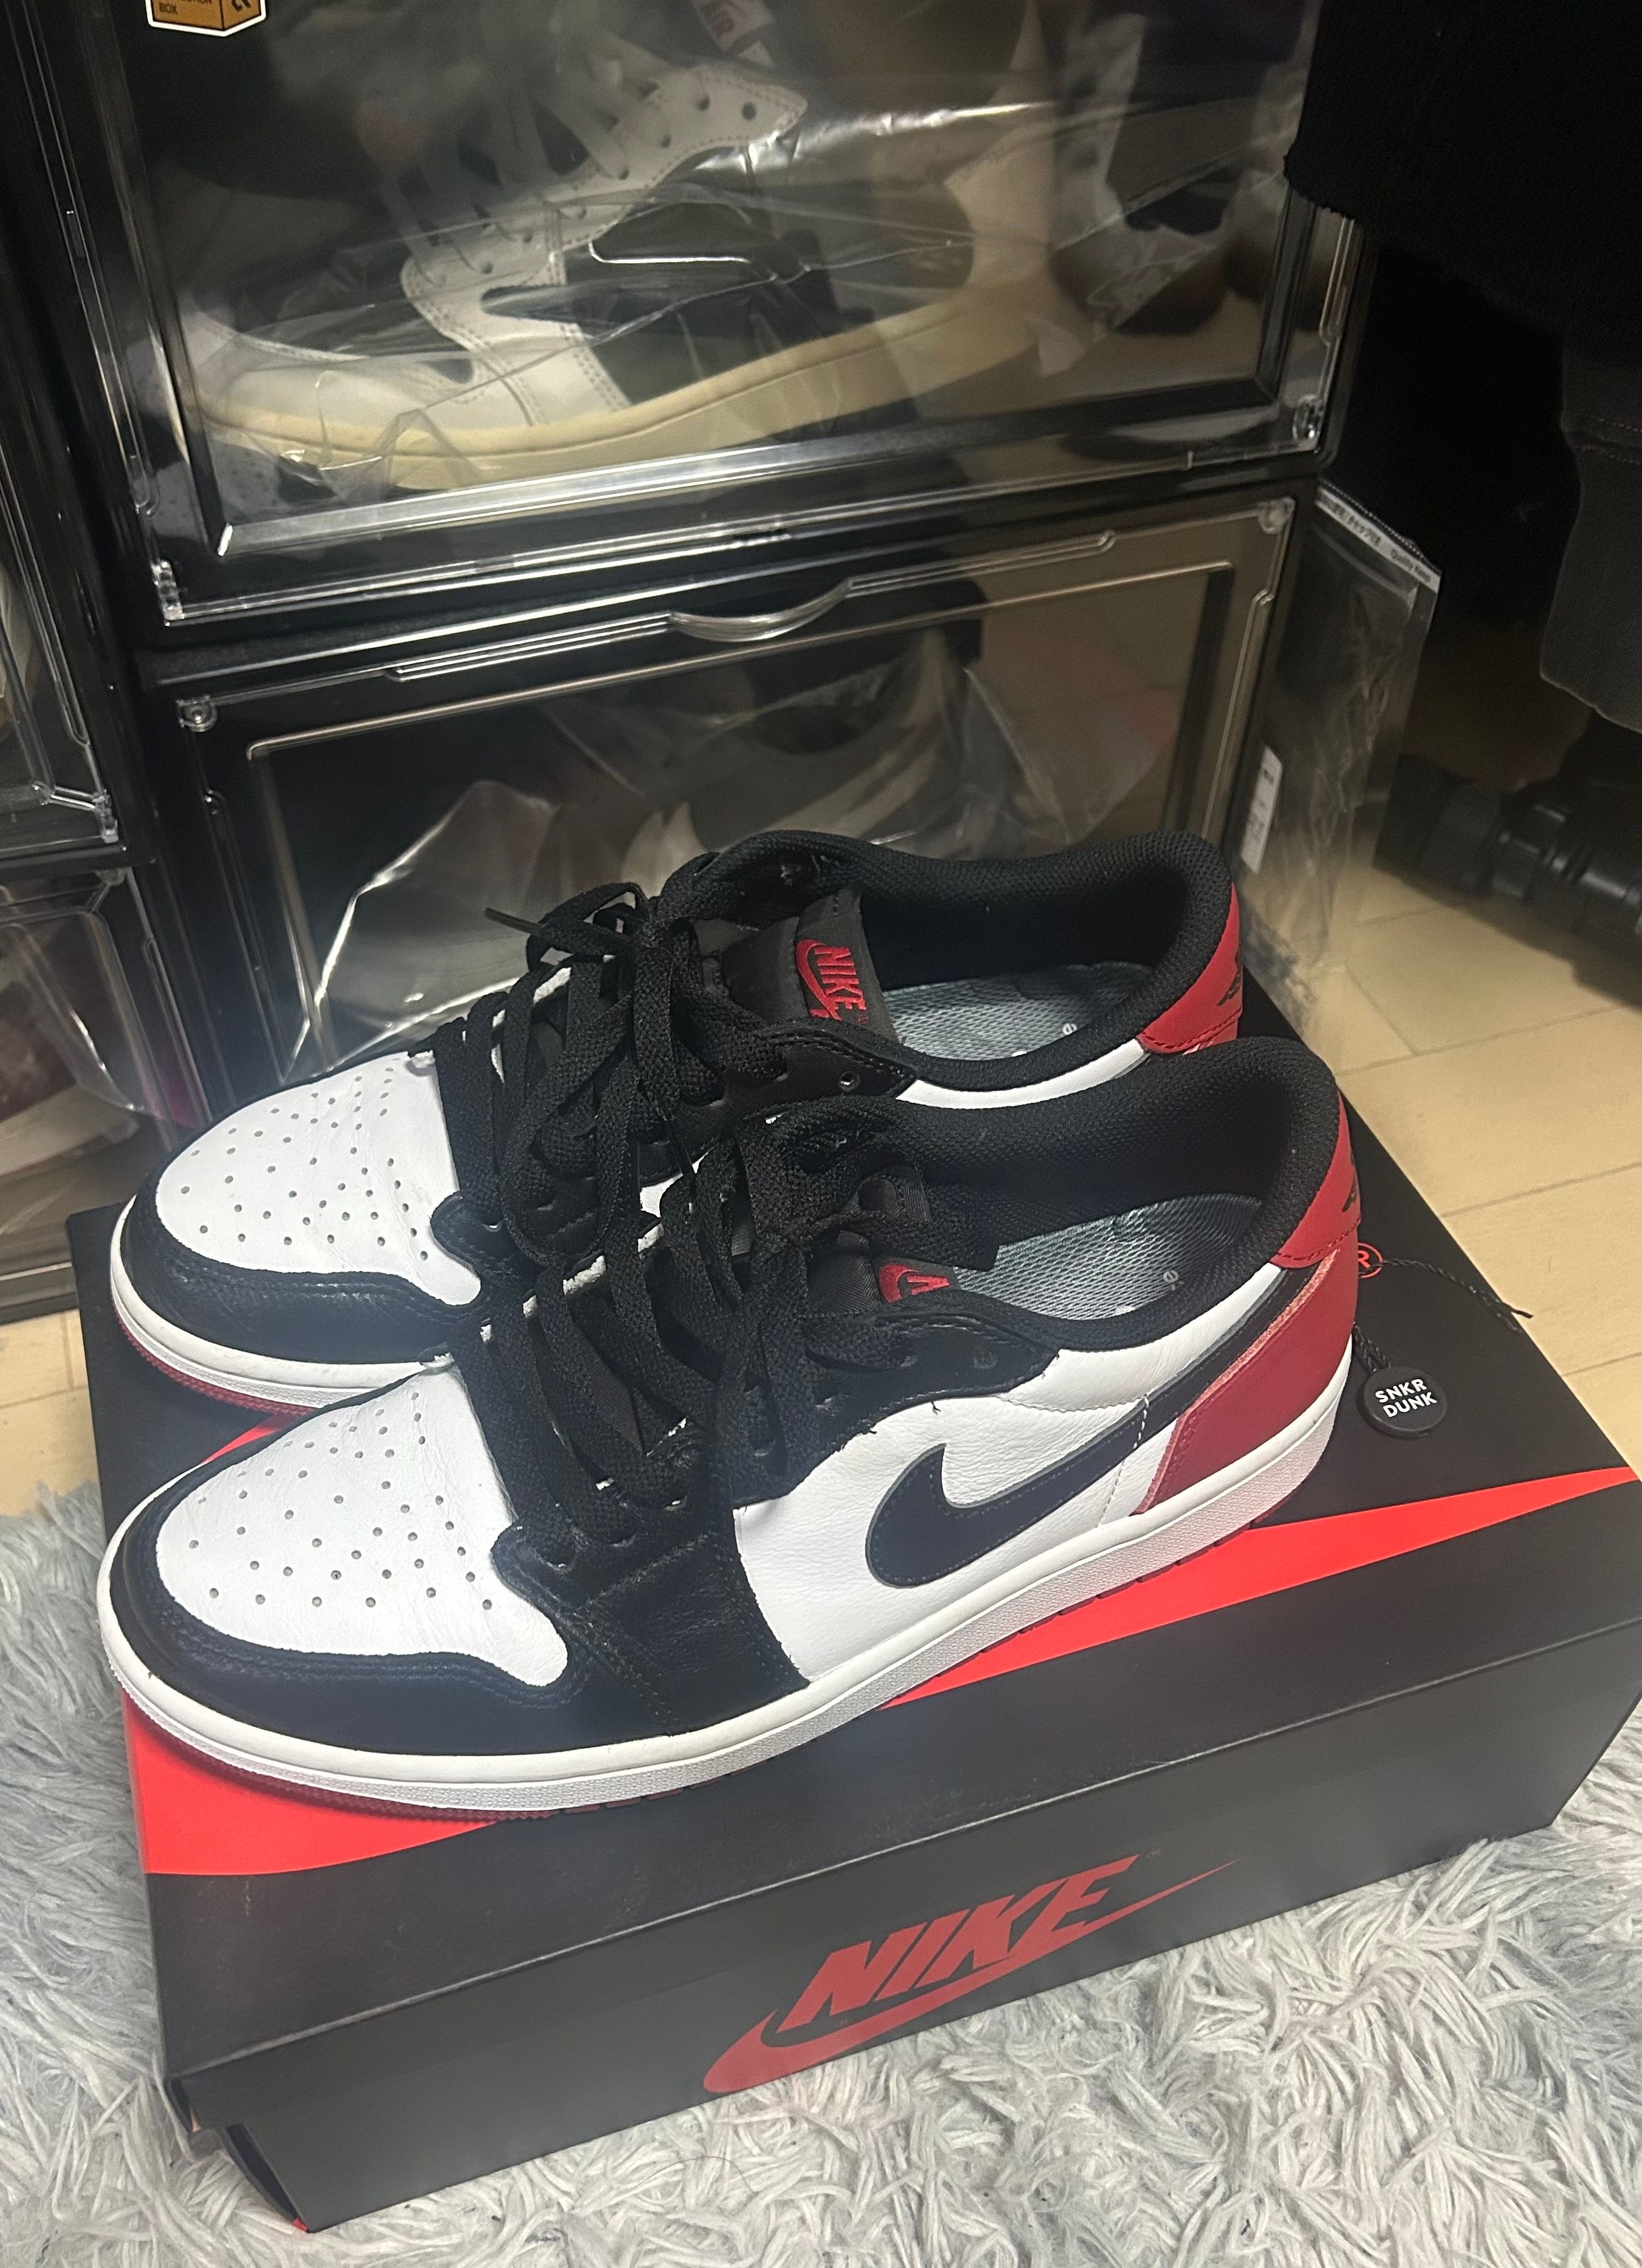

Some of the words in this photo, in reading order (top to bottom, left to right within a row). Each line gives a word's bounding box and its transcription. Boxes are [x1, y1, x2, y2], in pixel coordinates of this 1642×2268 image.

[159, 3, 178, 14] BOX
[814, 945, 867, 1011] NIKE
[1375, 1379, 1427, 1403] SNKR
[1383, 1392, 1437, 1418] DUNK
[775, 1854, 1140, 2033] NIKE
